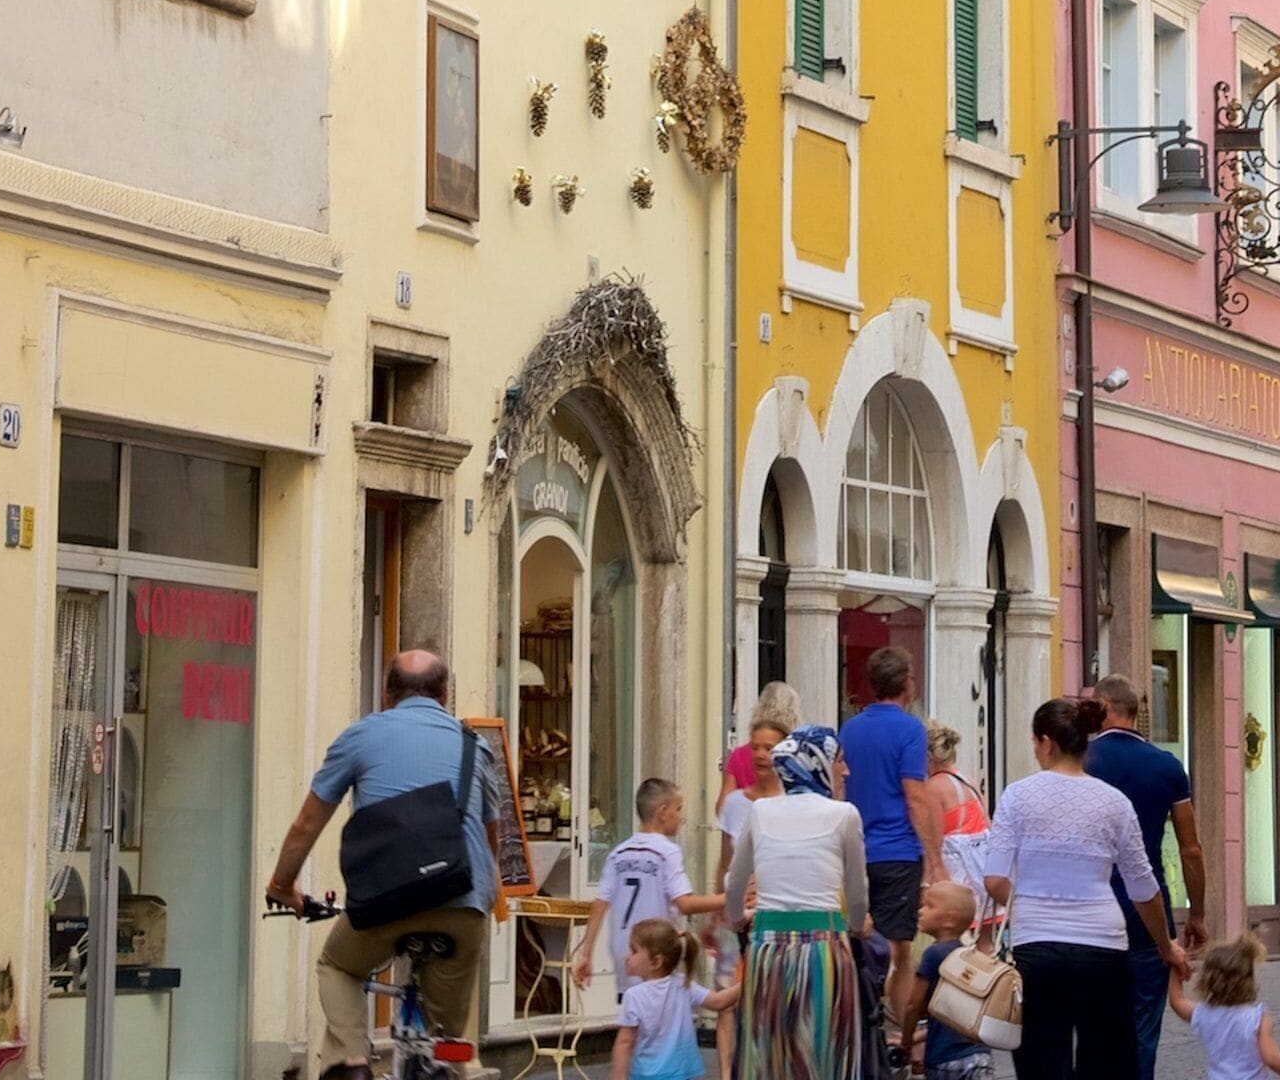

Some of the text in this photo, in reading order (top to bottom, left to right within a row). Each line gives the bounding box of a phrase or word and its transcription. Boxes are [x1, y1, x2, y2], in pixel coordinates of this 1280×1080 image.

[3, 408, 21, 442] 20
[135, 583, 254, 645] COIFFEUR
[621, 878, 640, 929] 7
